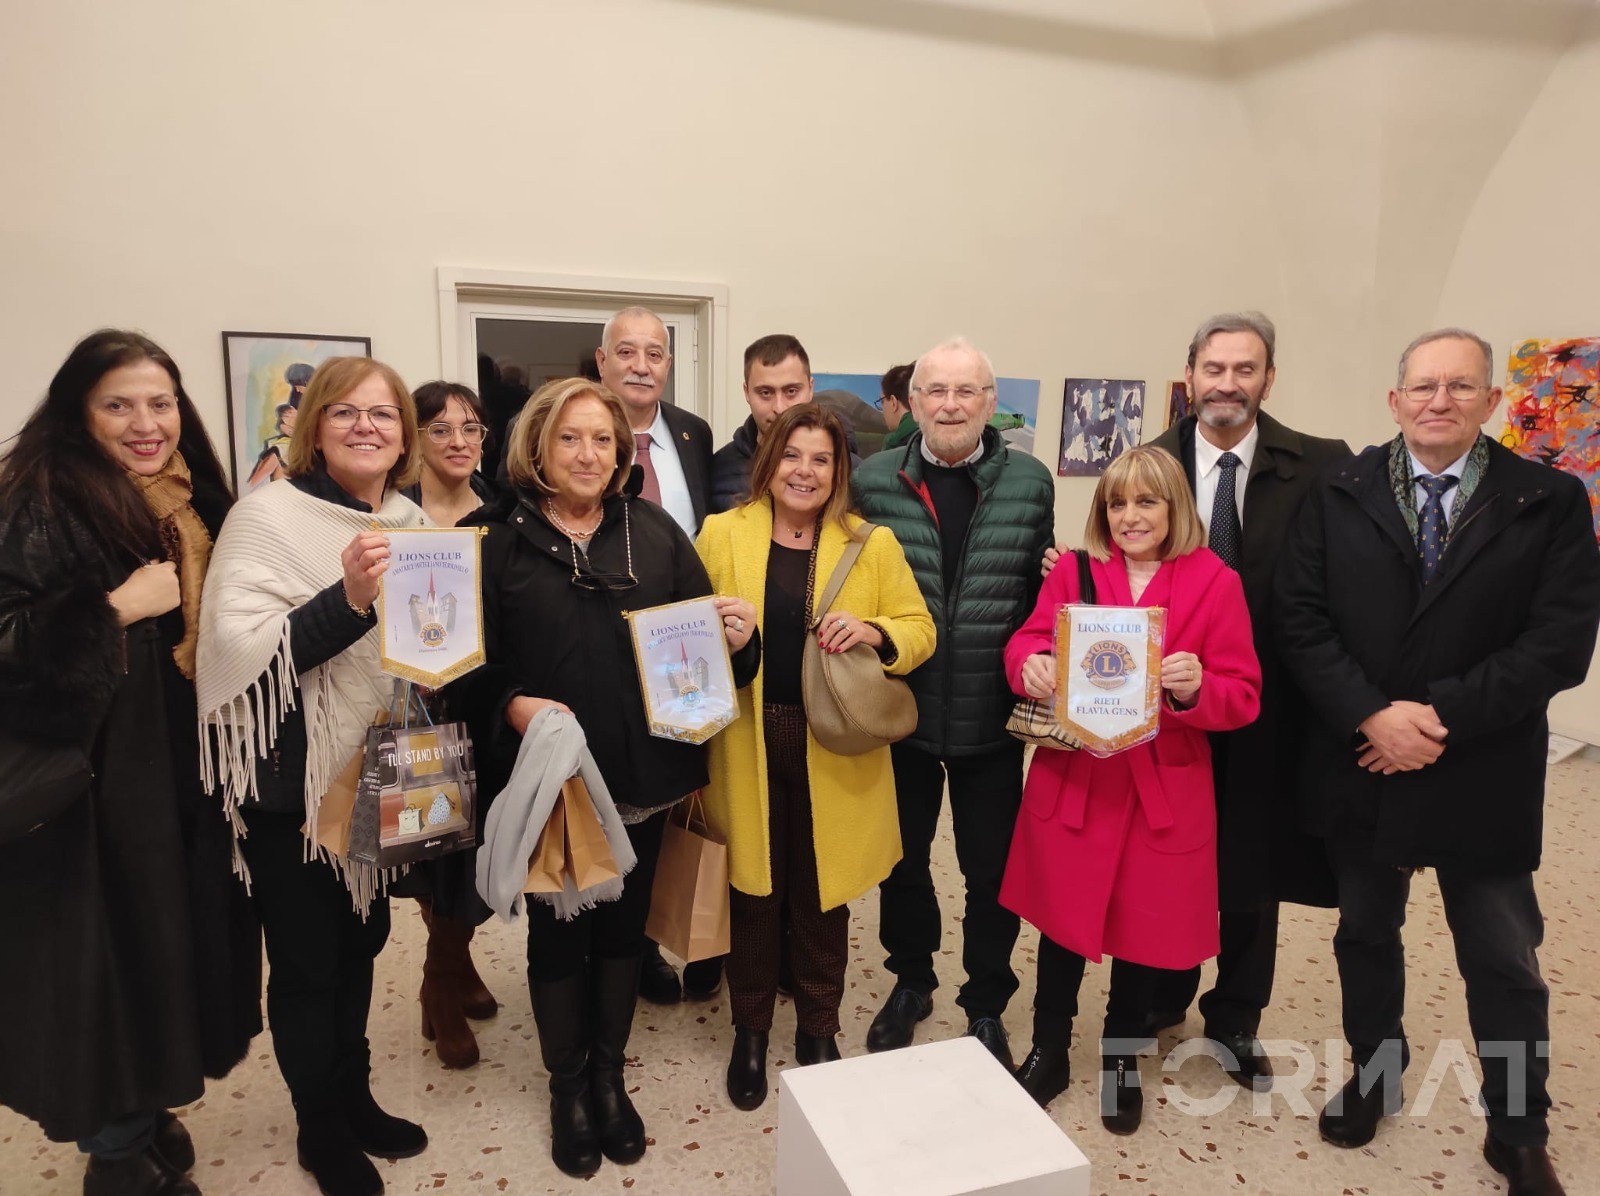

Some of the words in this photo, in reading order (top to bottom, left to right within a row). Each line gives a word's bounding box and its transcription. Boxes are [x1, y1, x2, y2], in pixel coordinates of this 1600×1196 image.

[399, 553, 431, 561] LIONS
[433, 552, 462, 560] CLUB
[651, 625, 680, 637] LIONS
[681, 620, 706, 631] CLUB
[1078, 623, 1111, 633] LIONS
[1113, 624, 1142, 633] CLUB
[1093, 642, 1125, 653] LIONS
[1102, 655, 1116, 673] L
[1094, 697, 1120, 705] RIETI
[1076, 706, 1109, 715] FLAVIA
[1111, 707, 1138, 716] GENS
[405, 748, 432, 765] STAND
[433, 746, 444, 760] BY
[447, 743, 464, 758] YOU
